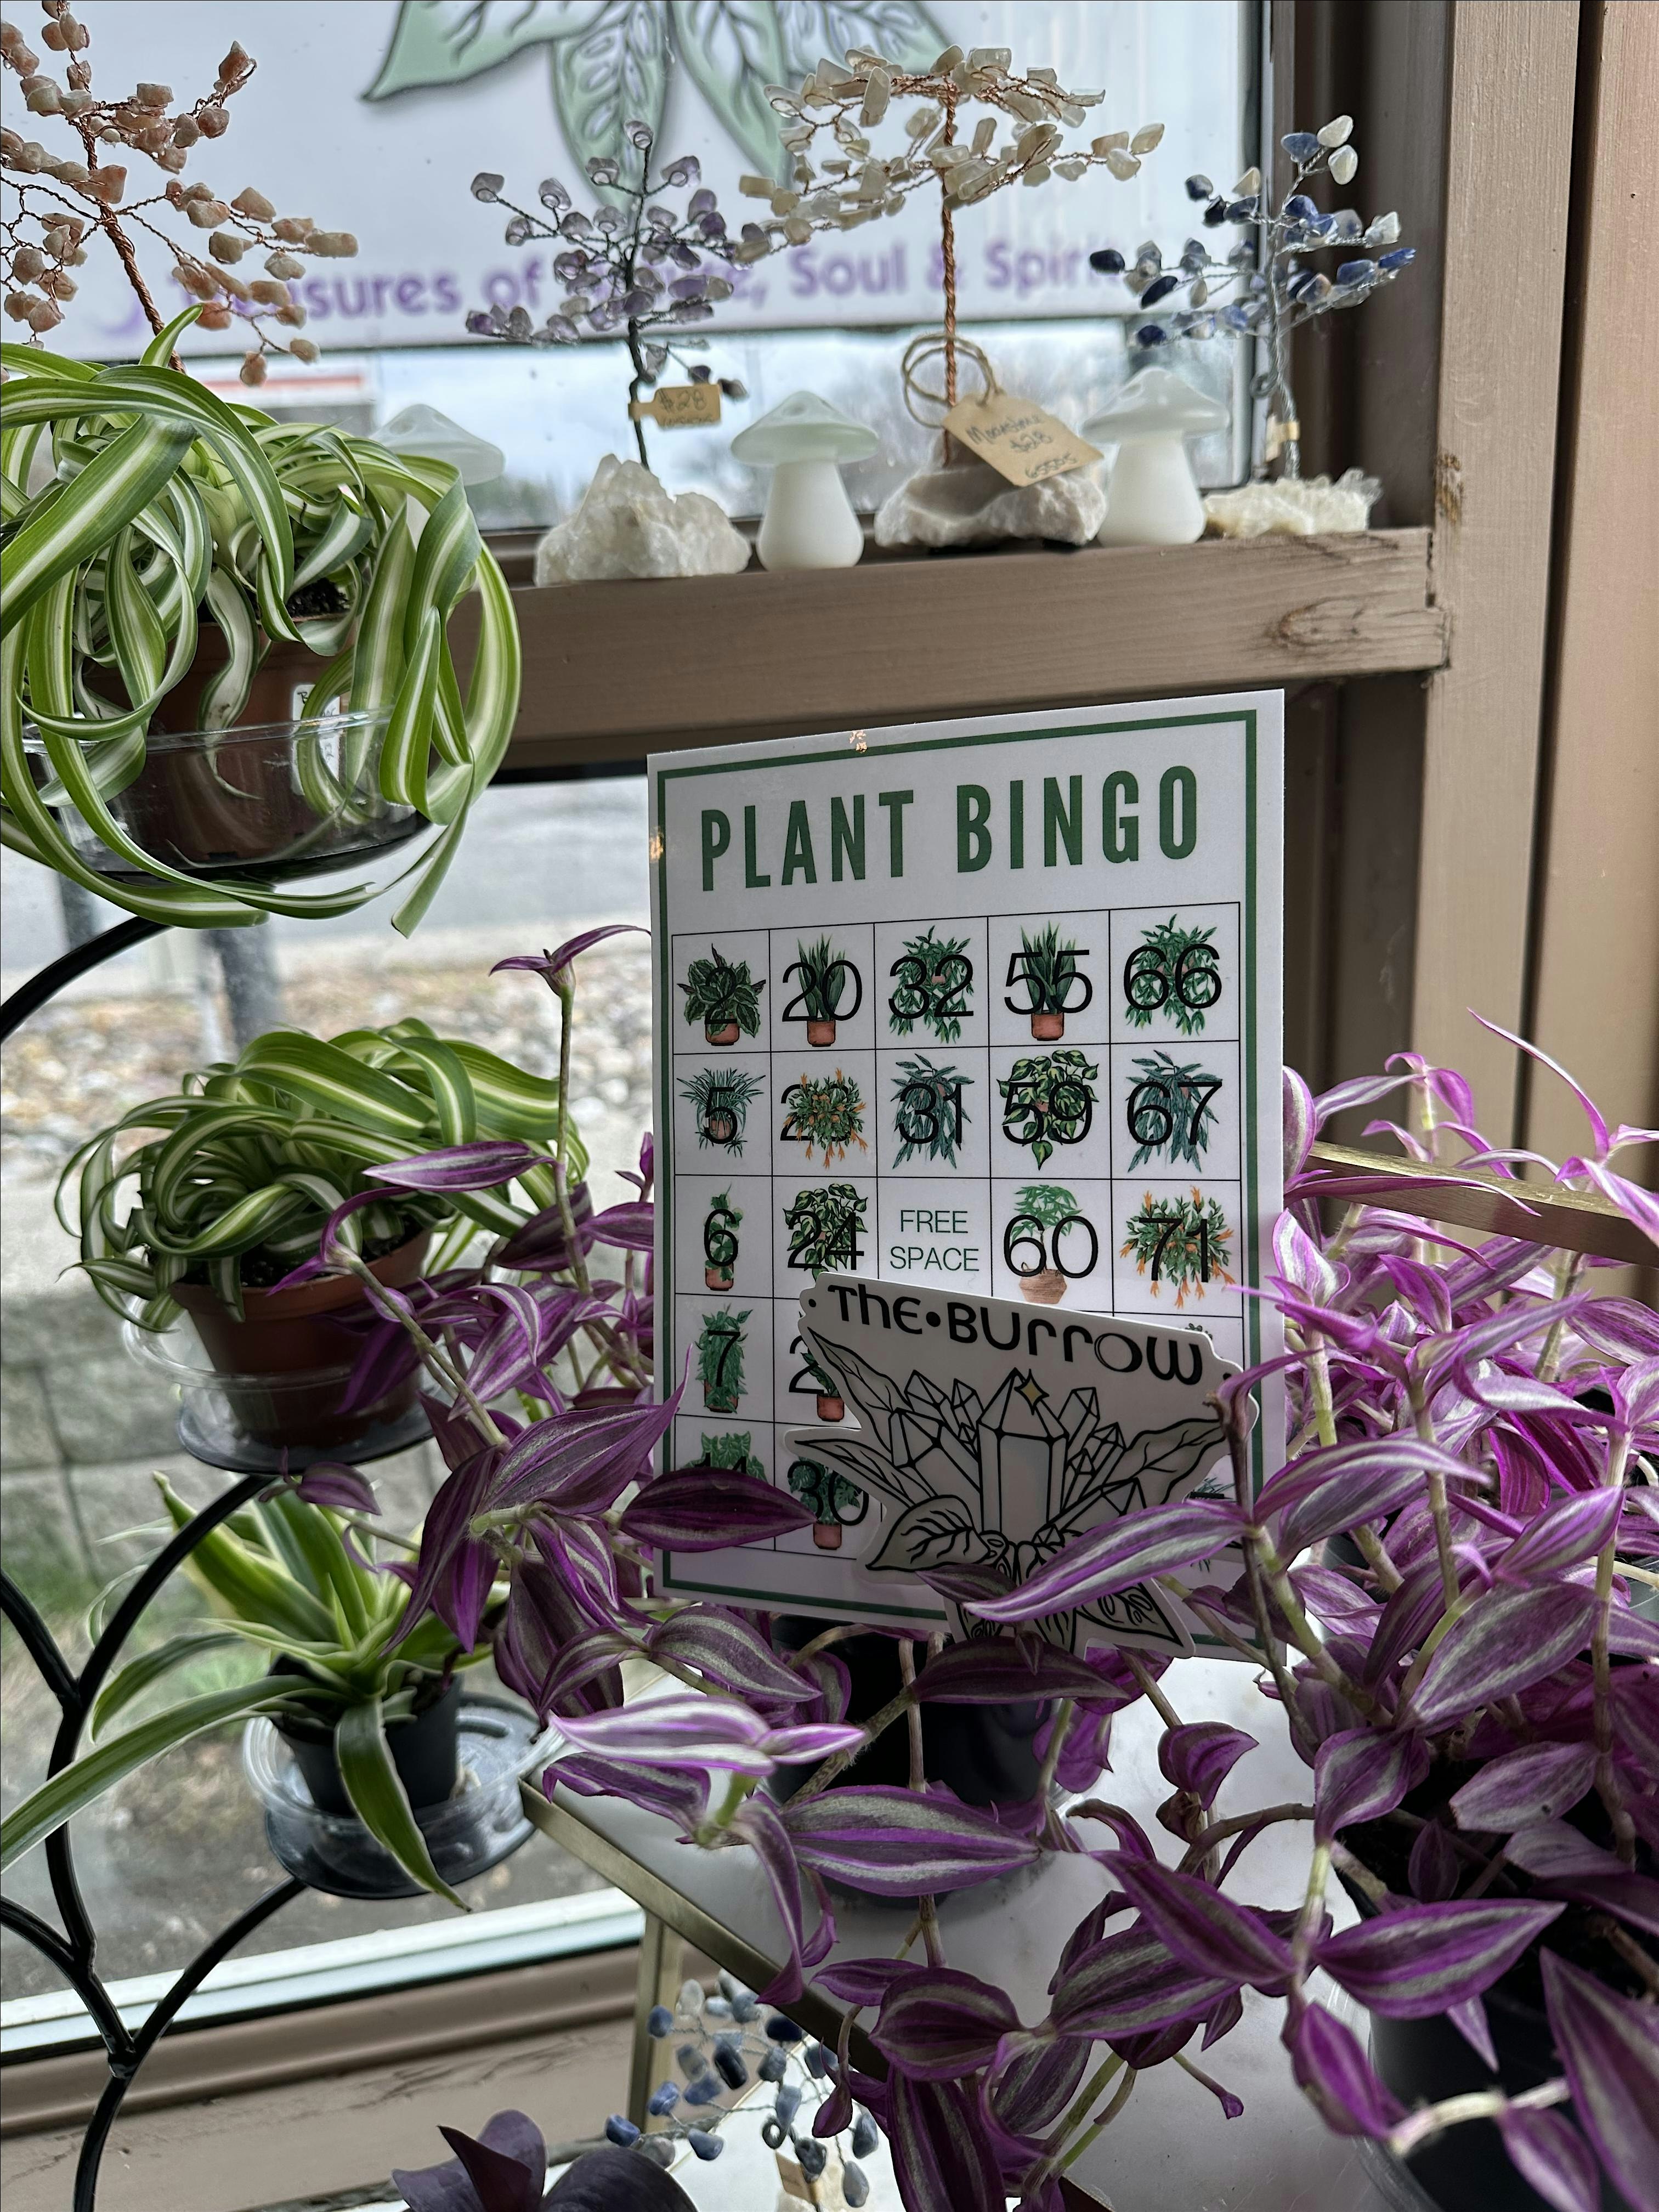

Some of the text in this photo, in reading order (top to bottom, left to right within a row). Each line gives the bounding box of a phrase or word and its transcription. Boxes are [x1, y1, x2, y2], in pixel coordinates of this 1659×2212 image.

[481, 255, 543, 308] of
[789, 238, 908, 296] Soul
[984, 235, 1123, 299] Spir
[701, 766, 1197, 892] PLANT BINGO
[705, 943, 1222, 1025] 2 20 32 55 66
[705, 1087, 738, 1145] 5
[898, 1083, 962, 1145] 31
[1002, 1081, 1093, 1145] 59
[1126, 1081, 1223, 1146] 67
[704, 1208, 1209, 1283] 6 24 60 71
[900, 1209, 969, 1234] FREE
[890, 1246, 980, 1271] SPACE
[707, 1330, 740, 1388] 7
[787, 1460, 869, 1526] 30
